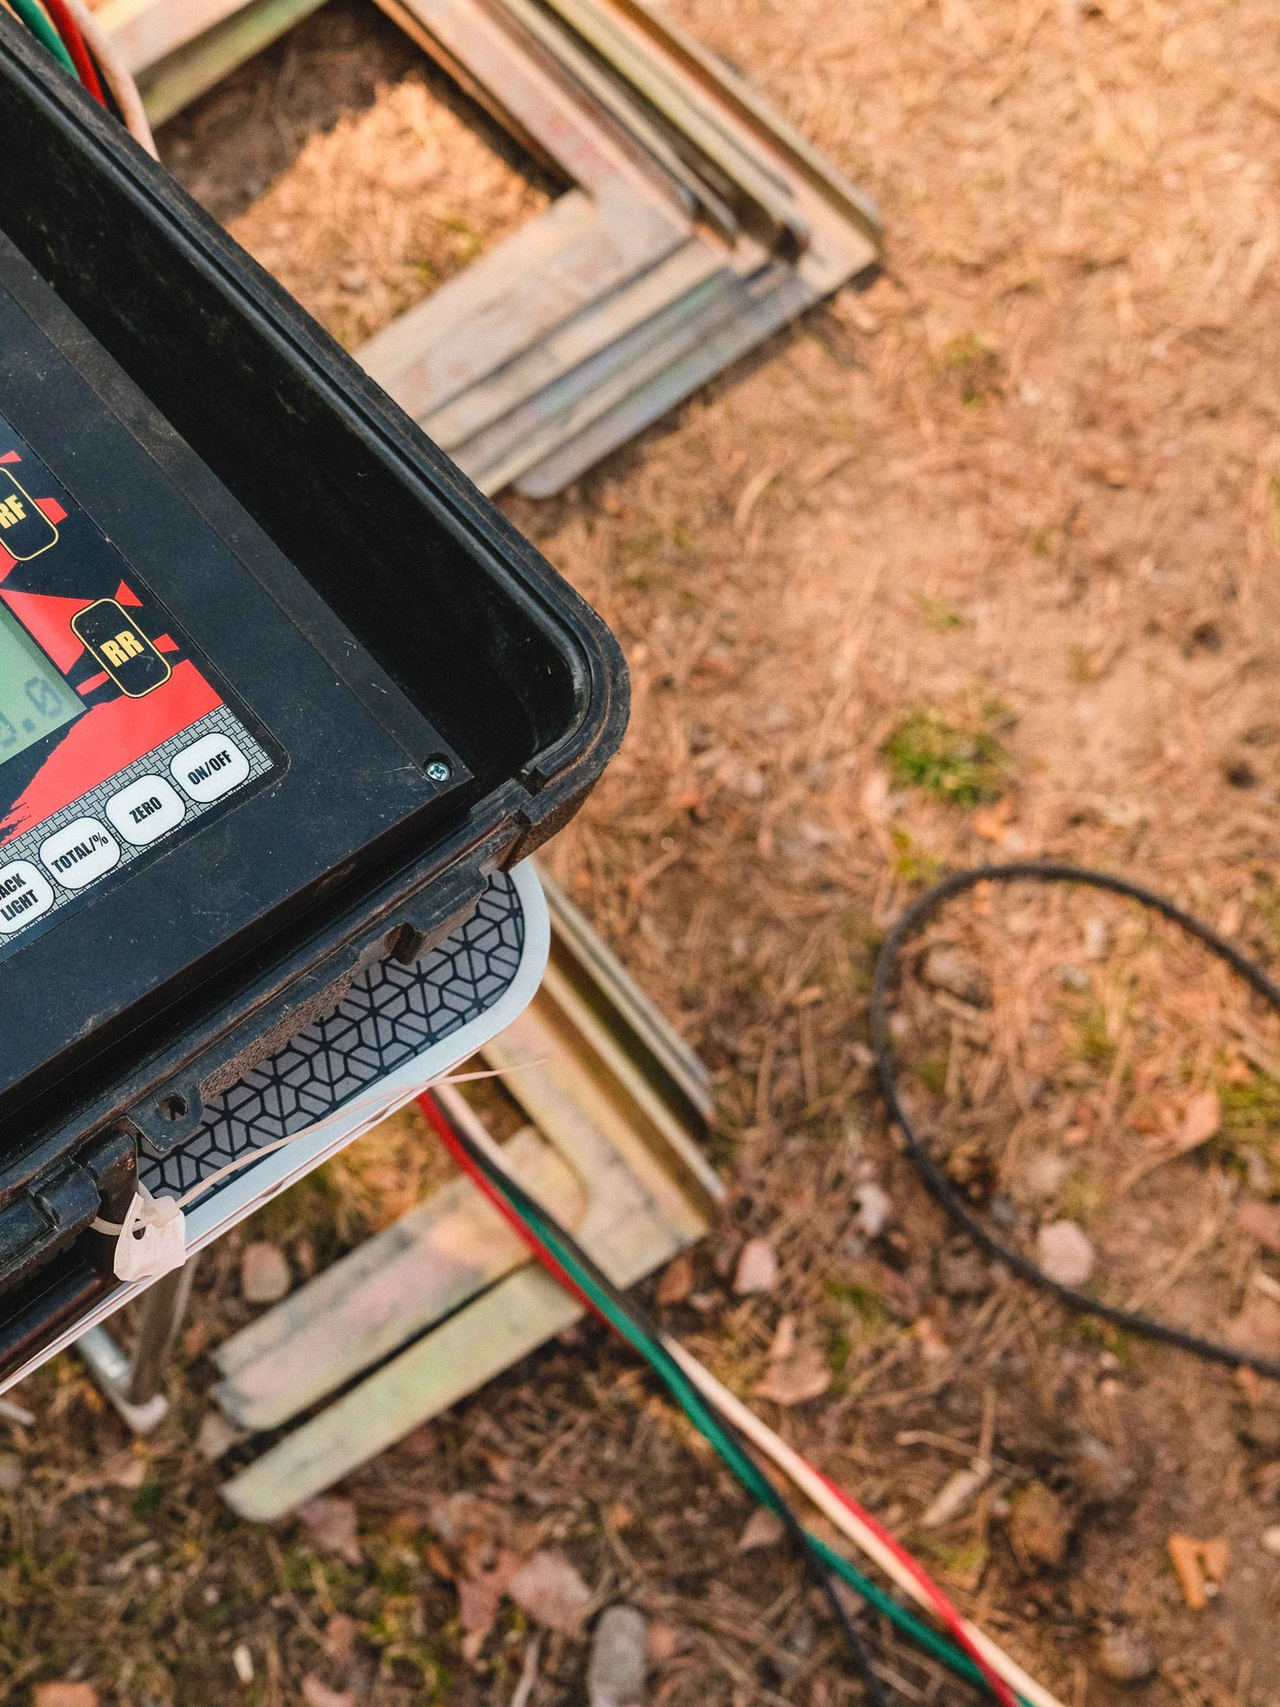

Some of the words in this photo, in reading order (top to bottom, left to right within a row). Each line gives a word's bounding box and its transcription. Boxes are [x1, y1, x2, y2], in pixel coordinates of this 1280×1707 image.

[99, 626, 145, 669] RR
[186, 748, 233, 786] ON/OFF
[127, 794, 163, 824] ZERO
[50, 830, 109, 874] TOTAL/%
[0, 888, 40, 922] LIGHT
